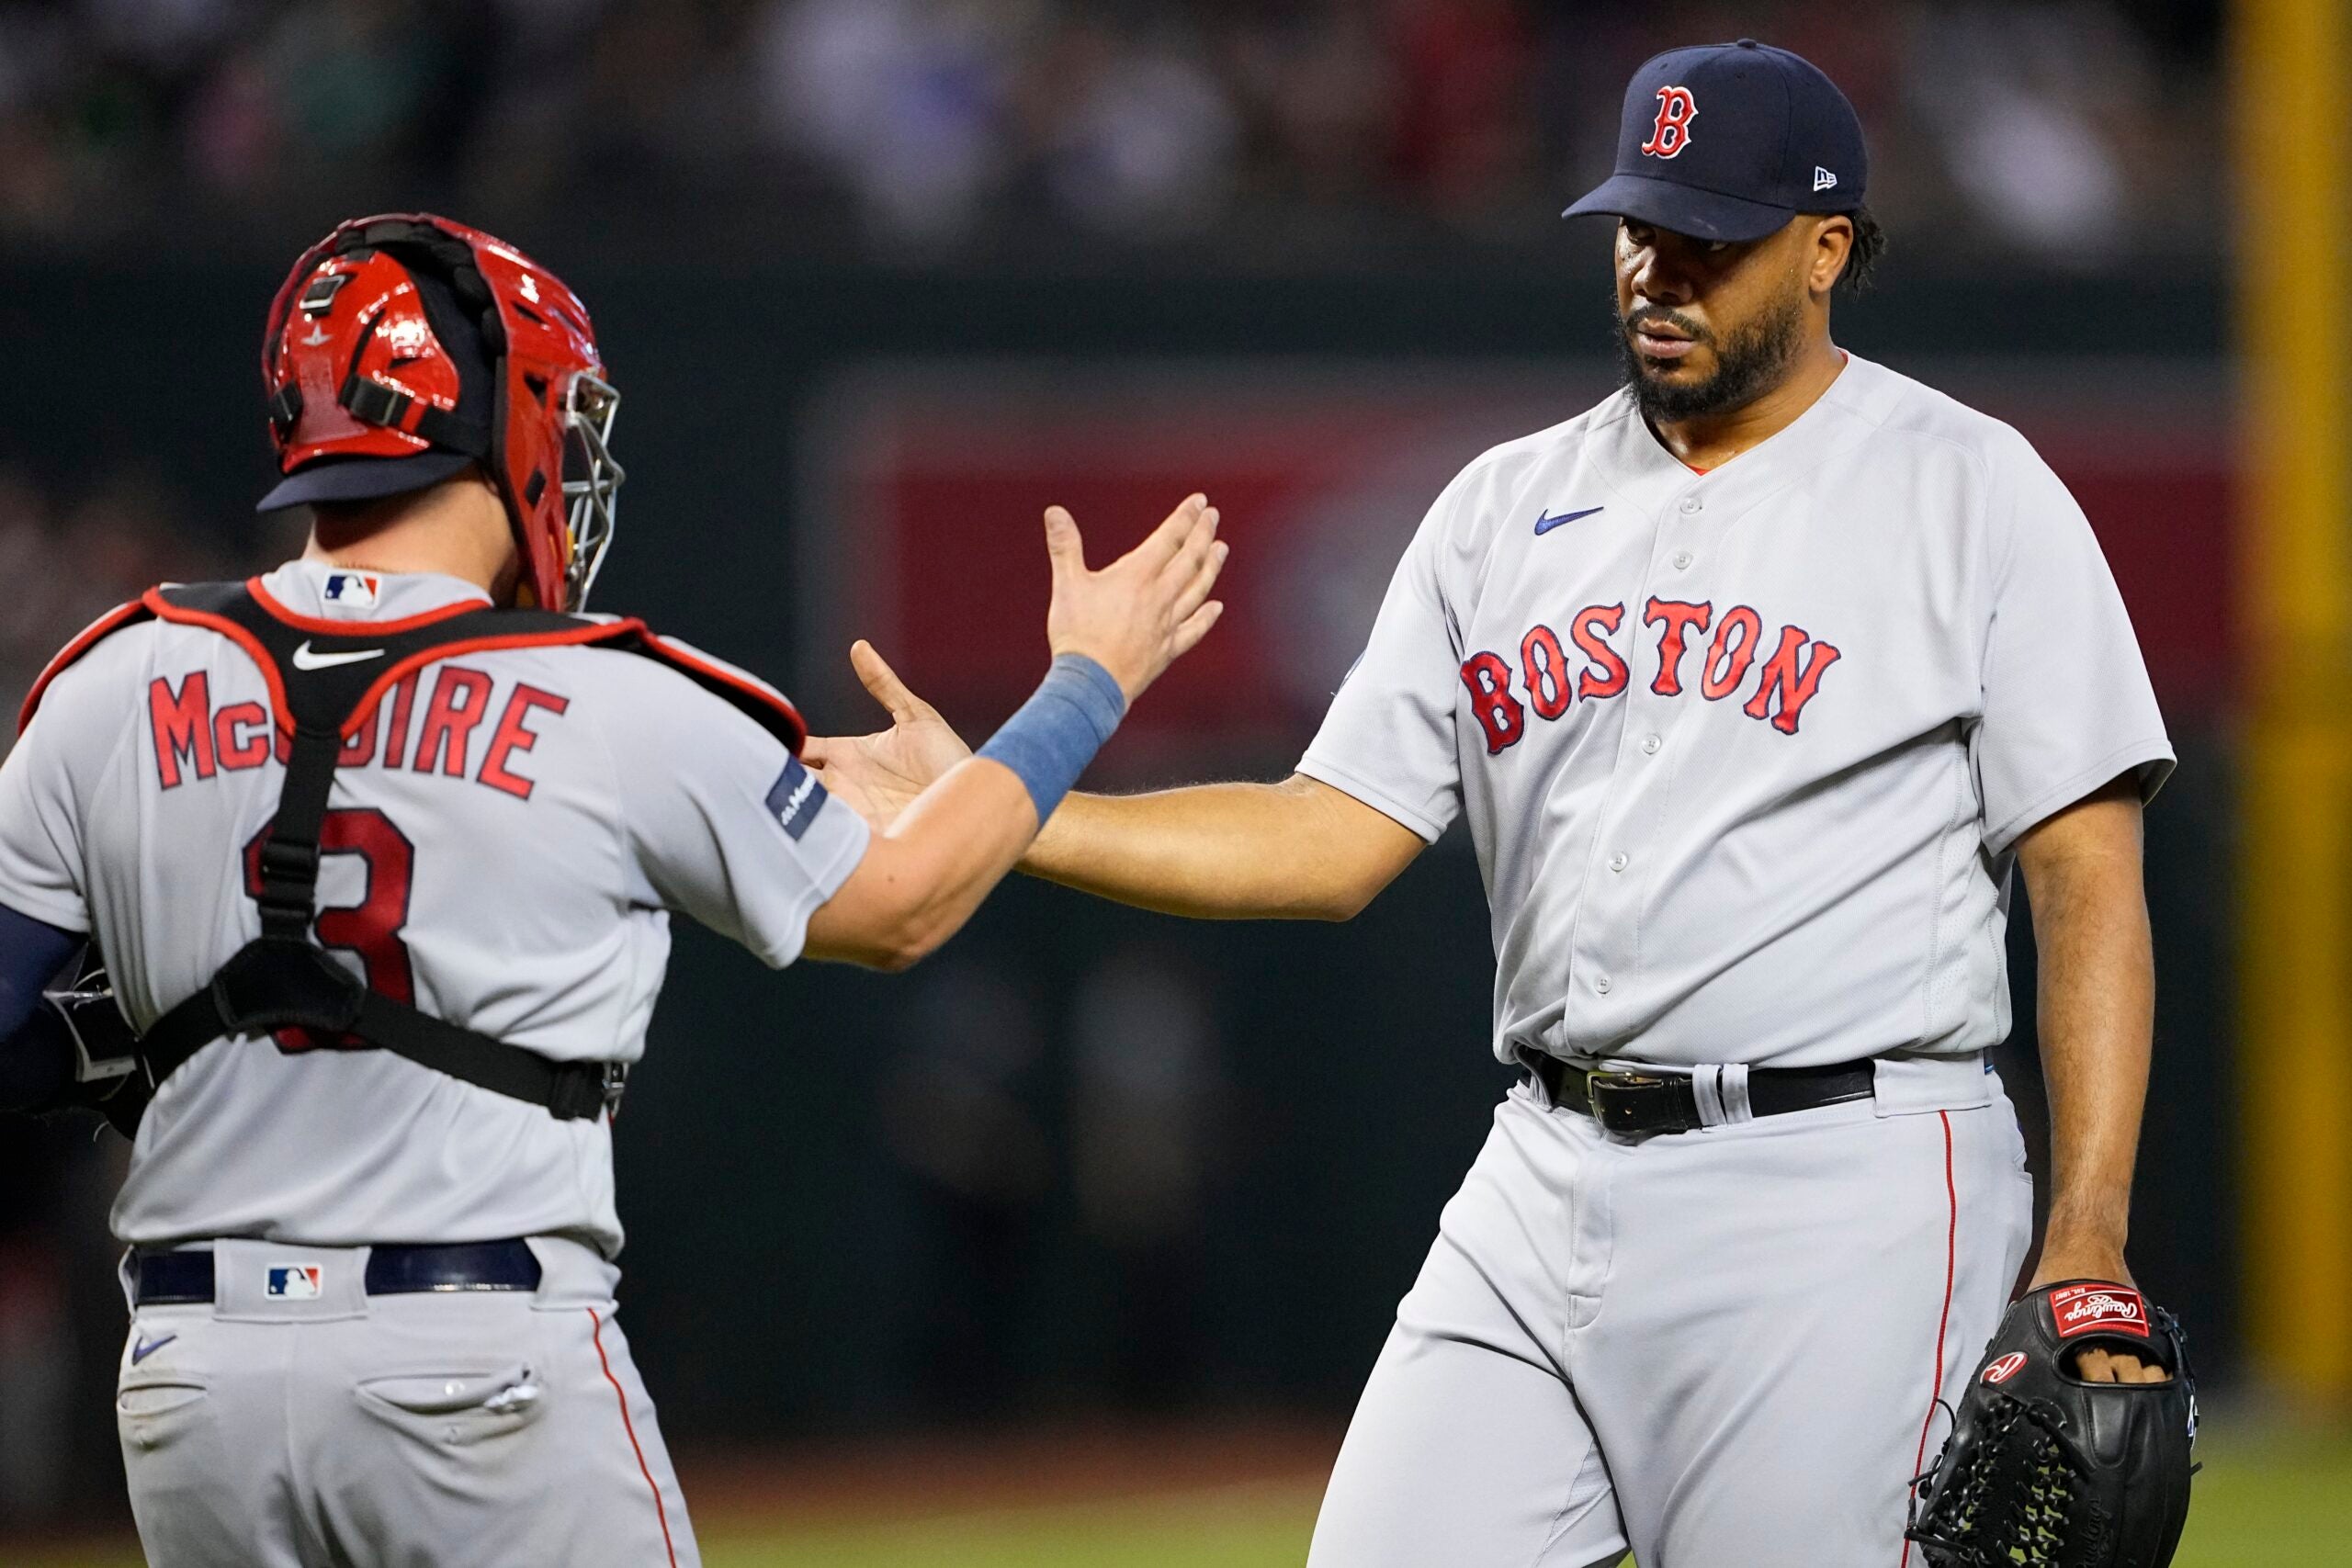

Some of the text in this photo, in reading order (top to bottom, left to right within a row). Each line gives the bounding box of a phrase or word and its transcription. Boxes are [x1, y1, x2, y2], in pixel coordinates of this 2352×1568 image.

[1641, 85, 1699, 159] B
[1460, 595, 1841, 755] BOSTON
[149, 666, 570, 798] McIRE
[2064, 1301, 2138, 1321] Rawlings
